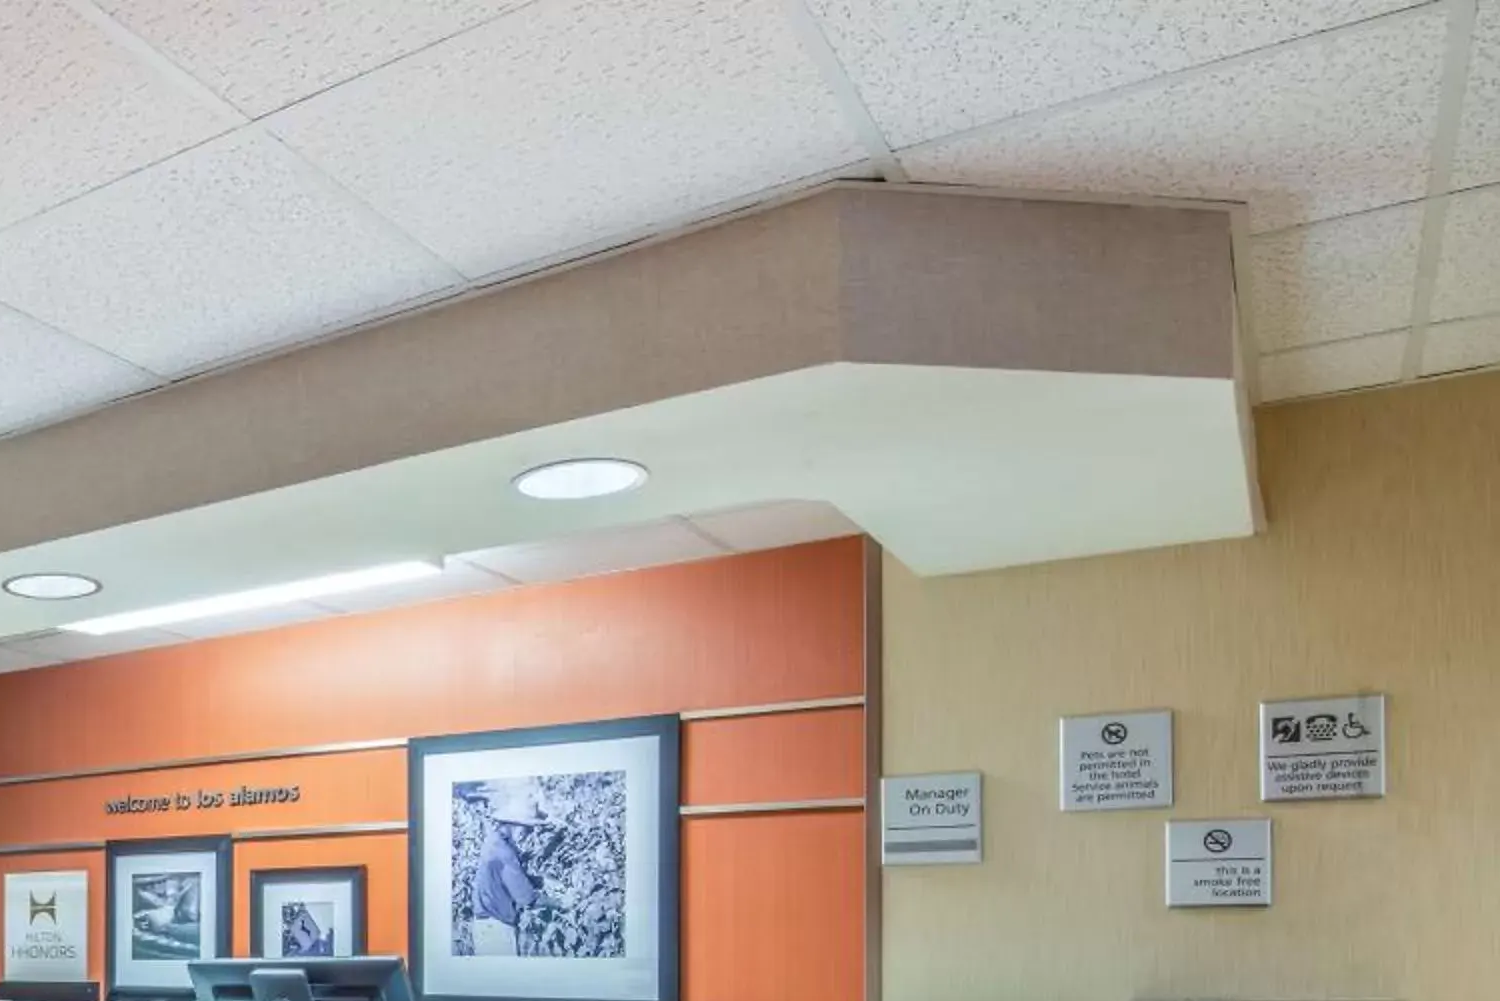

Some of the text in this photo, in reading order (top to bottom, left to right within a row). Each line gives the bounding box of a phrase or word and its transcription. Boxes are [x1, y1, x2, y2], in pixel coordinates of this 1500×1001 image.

[1129, 748, 1149, 757] not
[1079, 760, 1137, 772] permitted
[1267, 757, 1377, 771] We gladly provide
[1089, 768, 1141, 781] the hotel
[1275, 769, 1369, 782] assistive devices
[1115, 780, 1159, 790] animals
[1281, 781, 1363, 794] upon request
[106, 783, 301, 815] welcome to los alamos
[905, 788, 970, 801] Manager
[1075, 789, 1155, 803] are permitted
[909, 802, 970, 817] On Duty
[1193, 876, 1261, 887] smoke free
[1212, 888, 1261, 897] location
